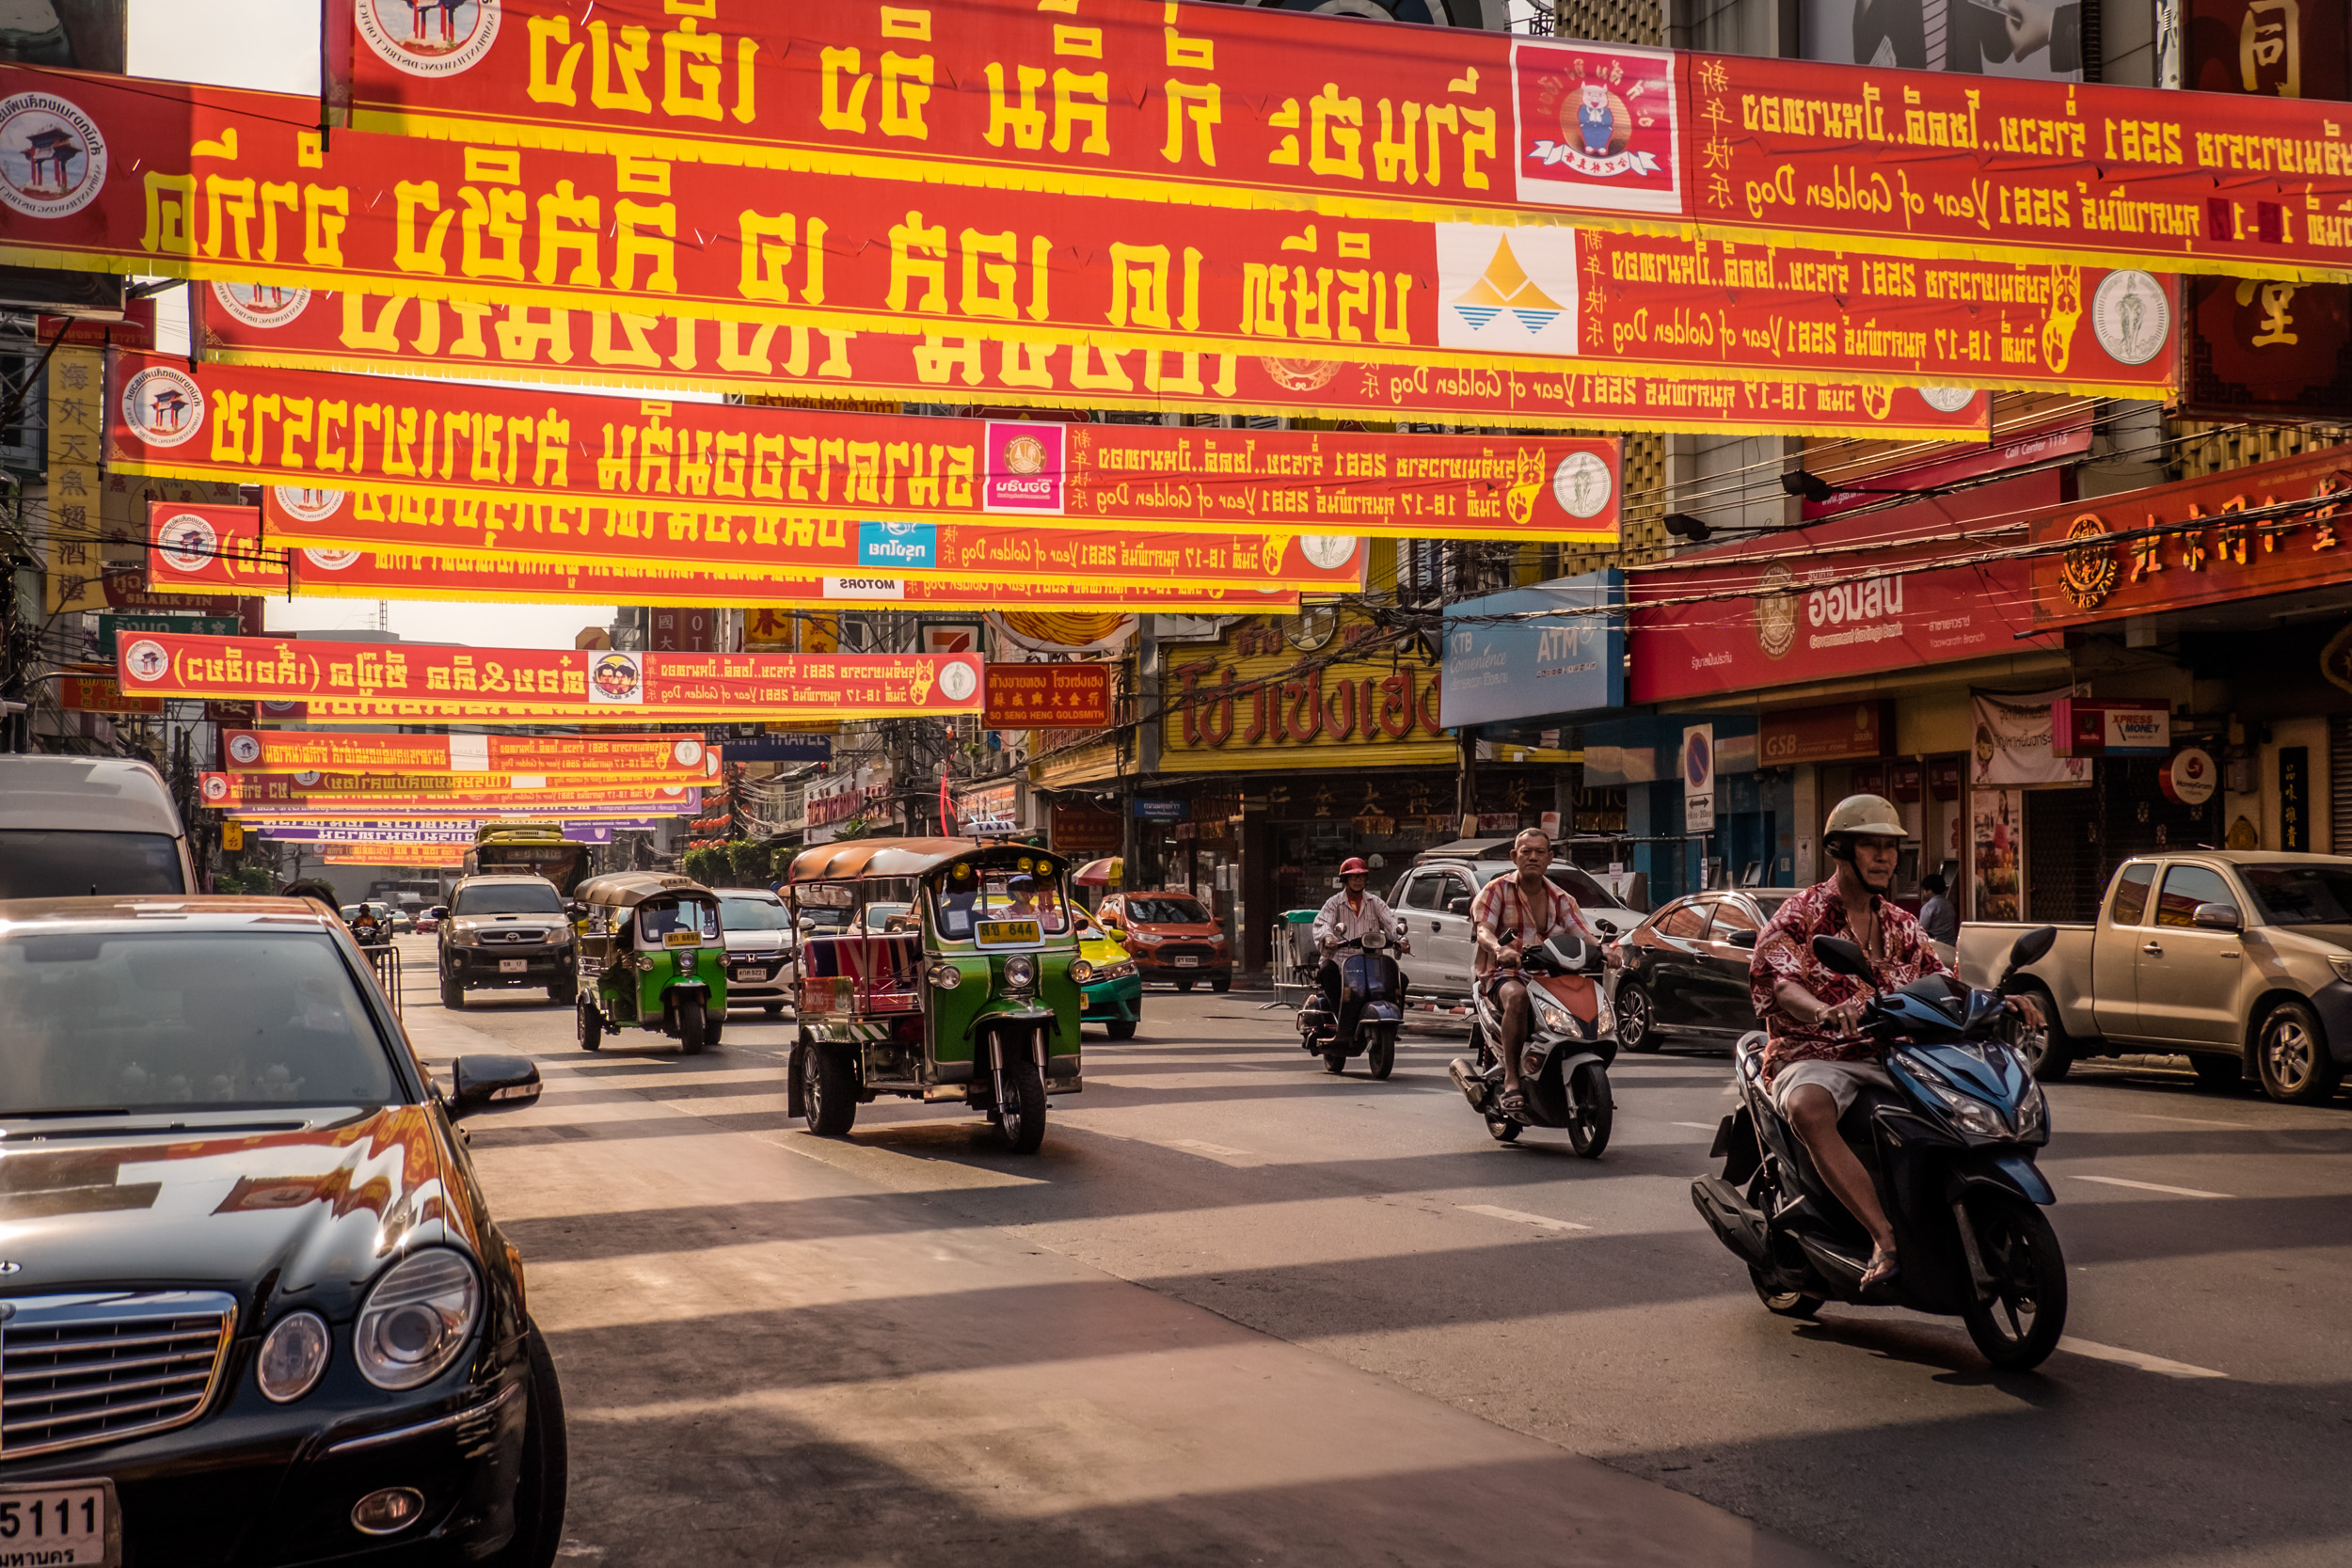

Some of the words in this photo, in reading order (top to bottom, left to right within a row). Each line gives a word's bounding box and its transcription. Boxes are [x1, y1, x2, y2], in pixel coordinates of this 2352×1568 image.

[2005, 444, 2020, 461] Call
[2021, 438, 2046, 456] Center
[2048, 434, 2069, 448] 1115
[2077, 591, 2098, 609] REN
[2097, 559, 2119, 594] TANG
[125, 594, 180, 607] SHARK
[185, 594, 213, 608] FIN
[1808, 567, 1902, 627] ออมสิน
[1929, 614, 1971, 632] สาขาเยาวราช
[1451, 631, 1472, 655] KTB
[1536, 626, 1578, 663] ATM
[1809, 628, 1853, 649] Government
[1854, 625, 1882, 643] Savings
[1882, 620, 1903, 639] Bank
[1963, 631, 1984, 643] Branch
[1451, 642, 1506, 673] Convenience
[989, 673, 1047, 688] ห้างขายทอง
[990, 710, 1002, 721] SO
[1004, 710, 1027, 721] SENG
[1030, 710, 1053, 720] HENG
[1056, 710, 1104, 720] GOLDSMITH
[2112, 714, 2153, 724] XPRESS
[2125, 723, 2161, 733] MONEY
[1766, 734, 1797, 756] GSB
[1827, 742, 1848, 751] ZONE
[976, 821, 1011, 832] TAXI
[1009, 923, 1033, 937] 644
[0, 1496, 95, 1538] 5111
